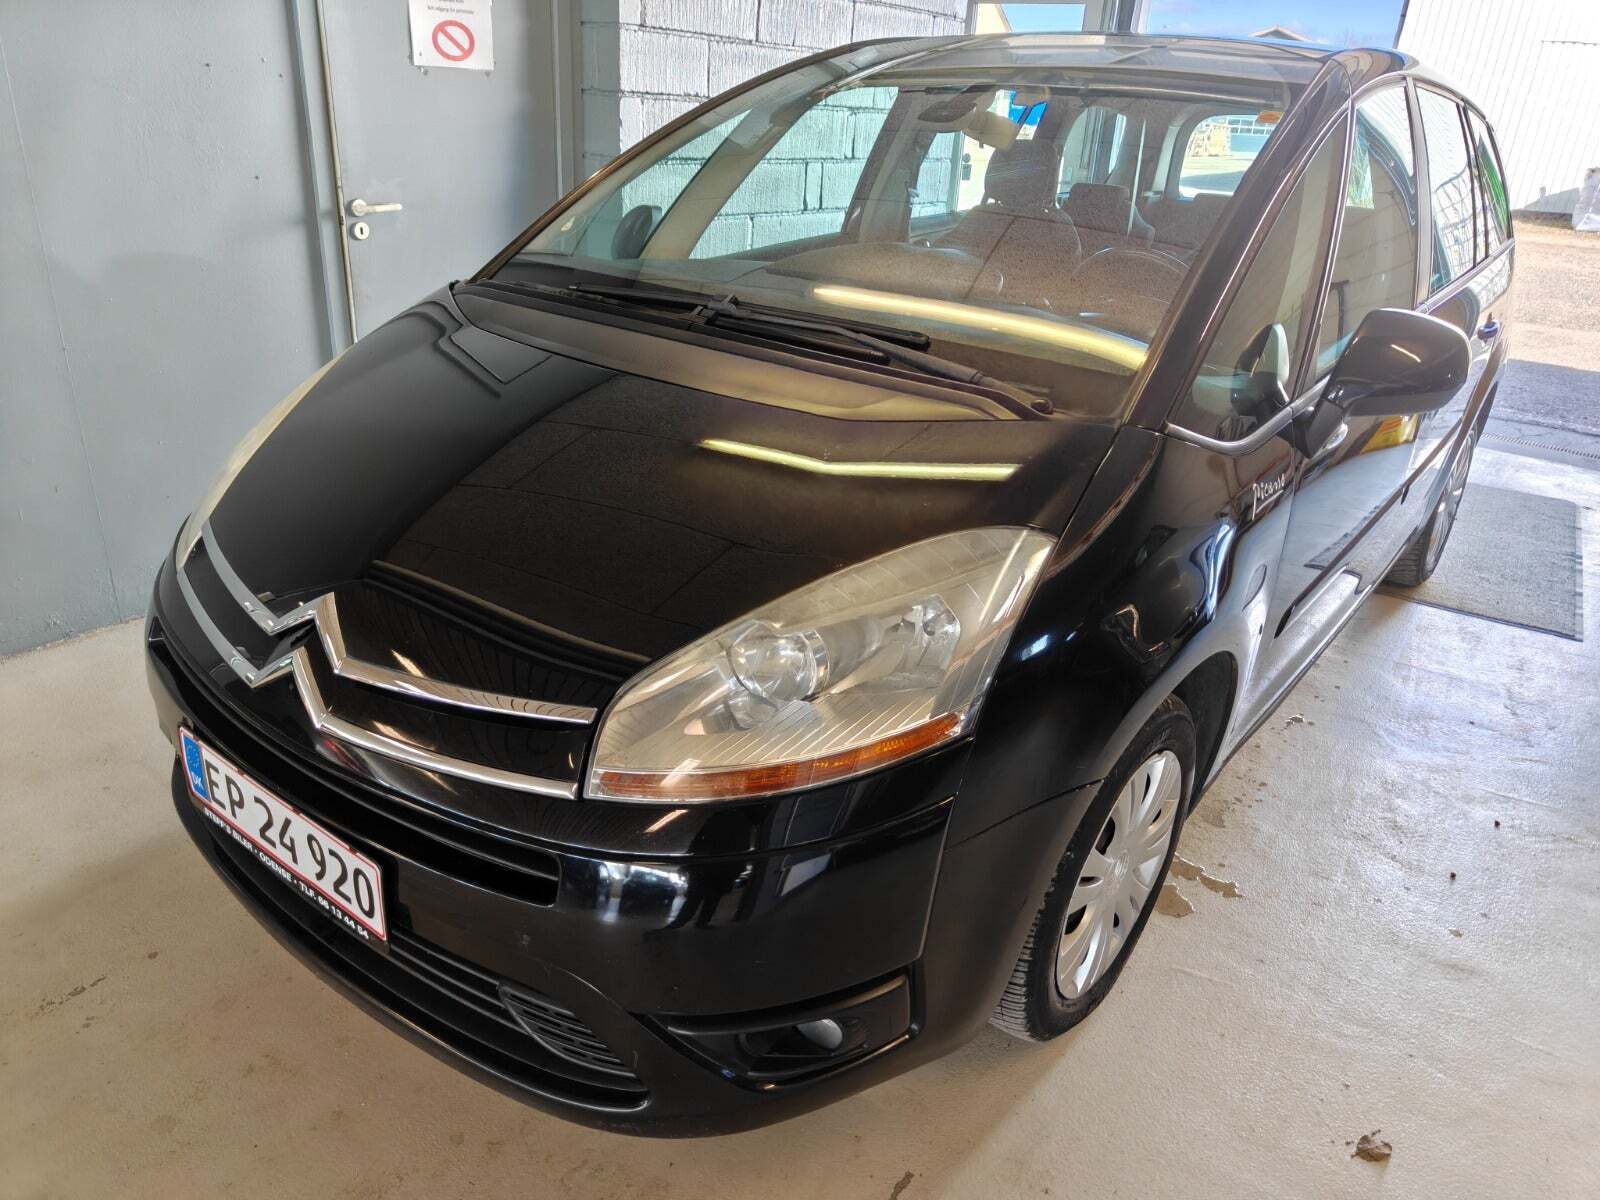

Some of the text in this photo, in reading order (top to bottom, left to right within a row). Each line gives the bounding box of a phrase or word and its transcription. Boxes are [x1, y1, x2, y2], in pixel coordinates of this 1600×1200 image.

[1252, 473, 1286, 521] Picasso
[191, 771, 204, 789] DK
[204, 758, 375, 920] EP 24 920
[259, 852, 292, 882] ODENSE
